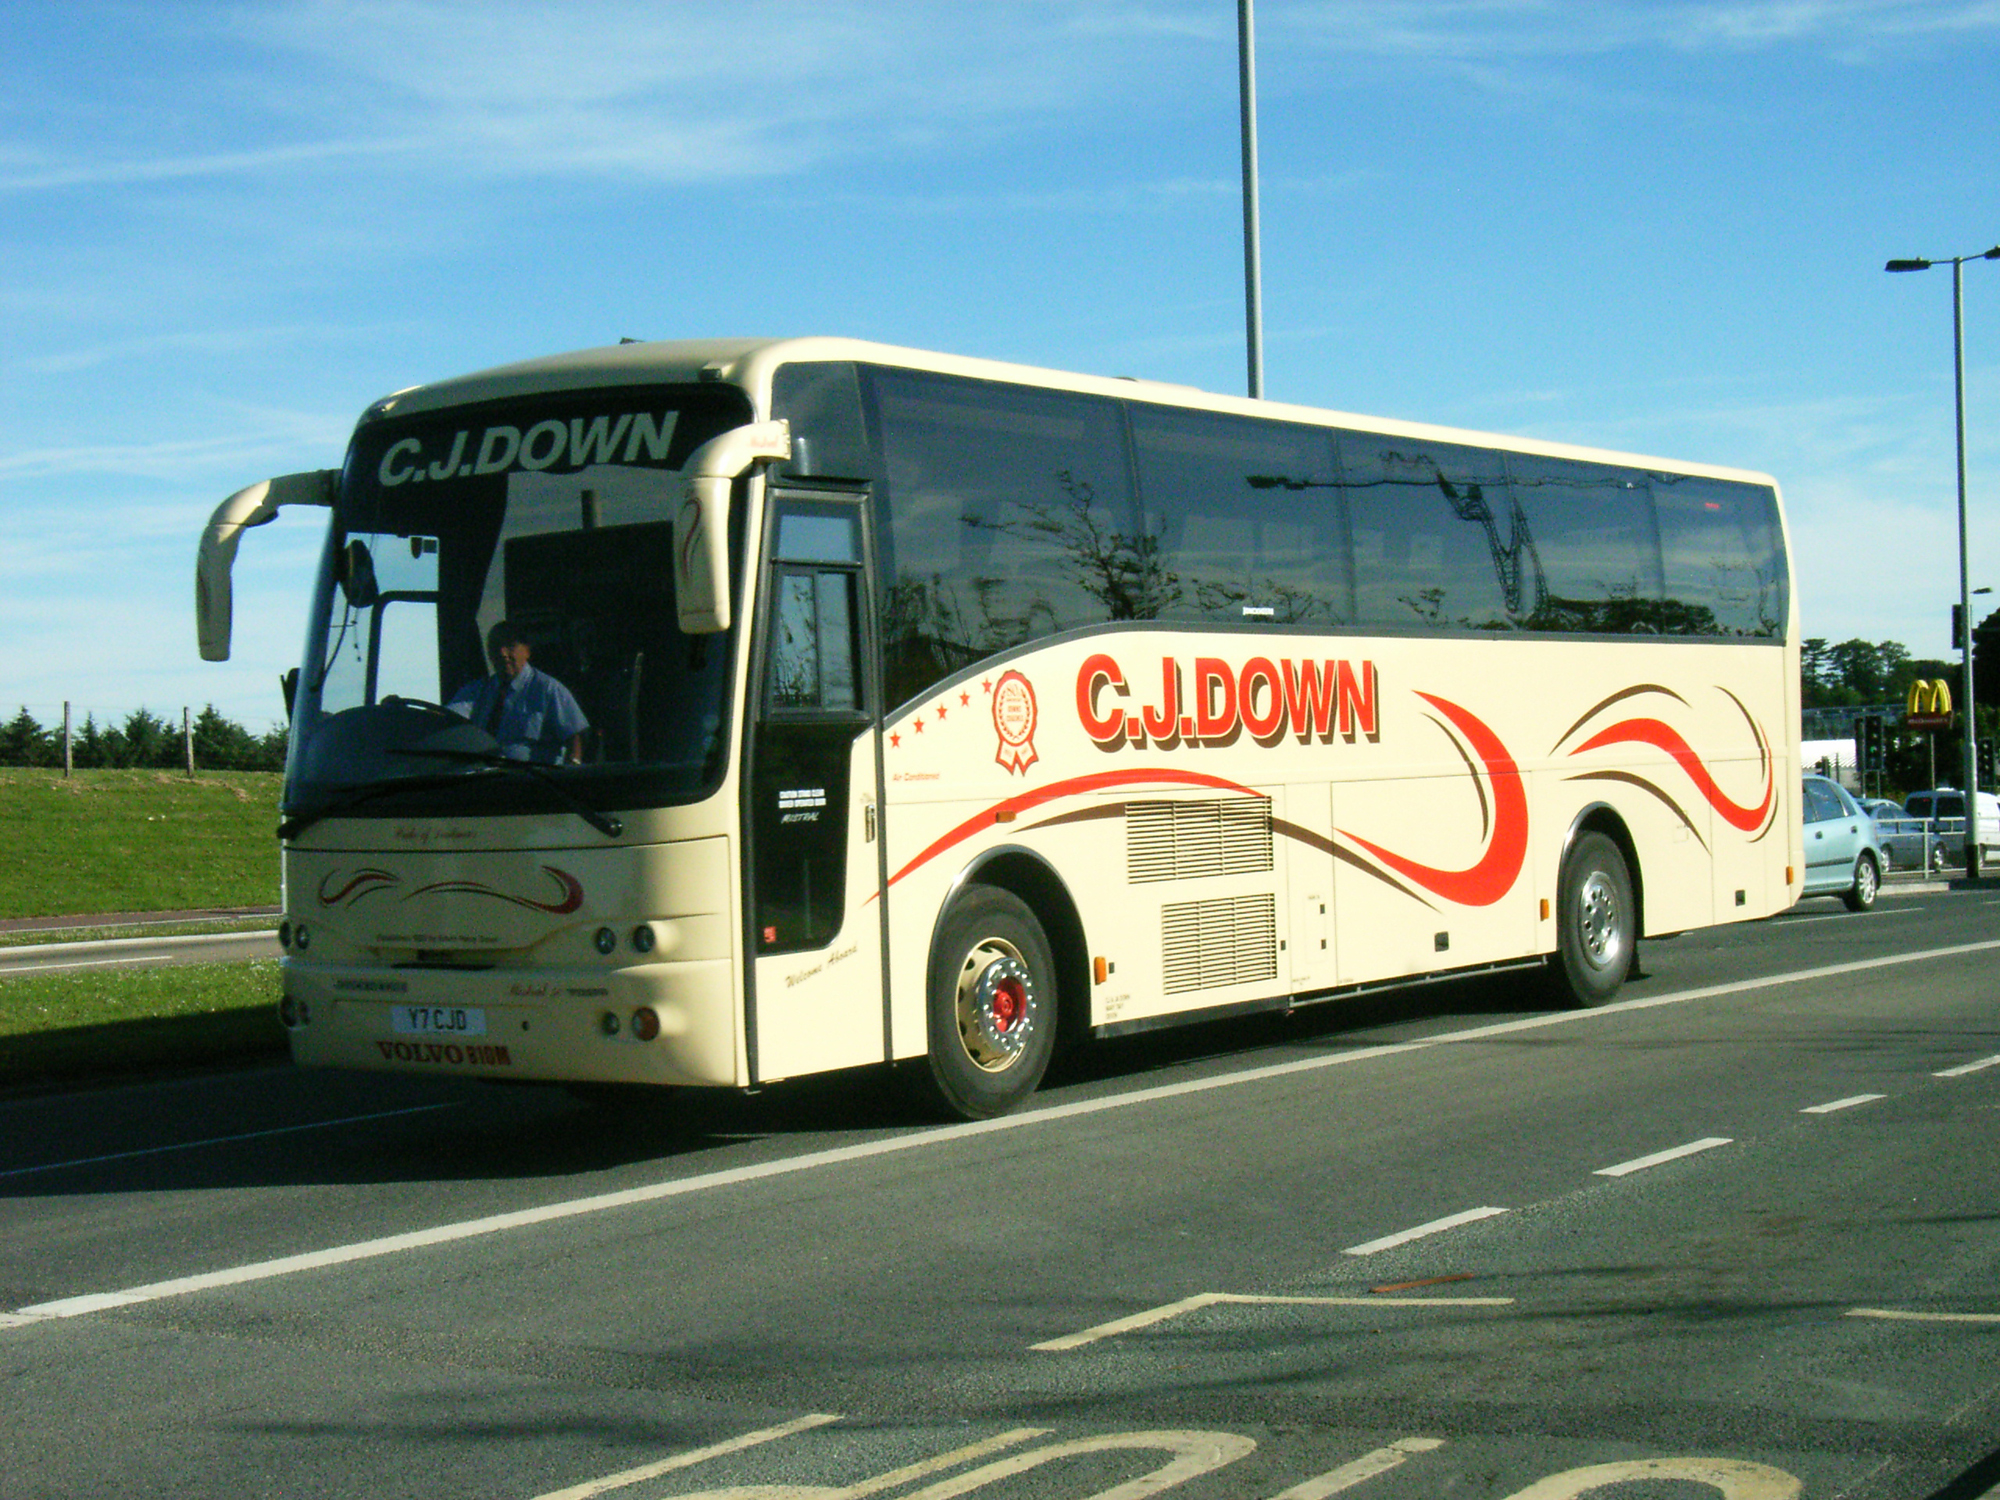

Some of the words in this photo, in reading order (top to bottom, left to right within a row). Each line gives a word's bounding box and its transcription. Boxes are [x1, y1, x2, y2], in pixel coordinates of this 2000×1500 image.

[378, 410, 680, 487] C.J.DOWN
[1076, 653, 1380, 753] C.J.DOWN
[408, 1008, 429, 1029] Y7
[433, 1009, 468, 1031] CJD
[376, 1041, 464, 1064] VOLVO
